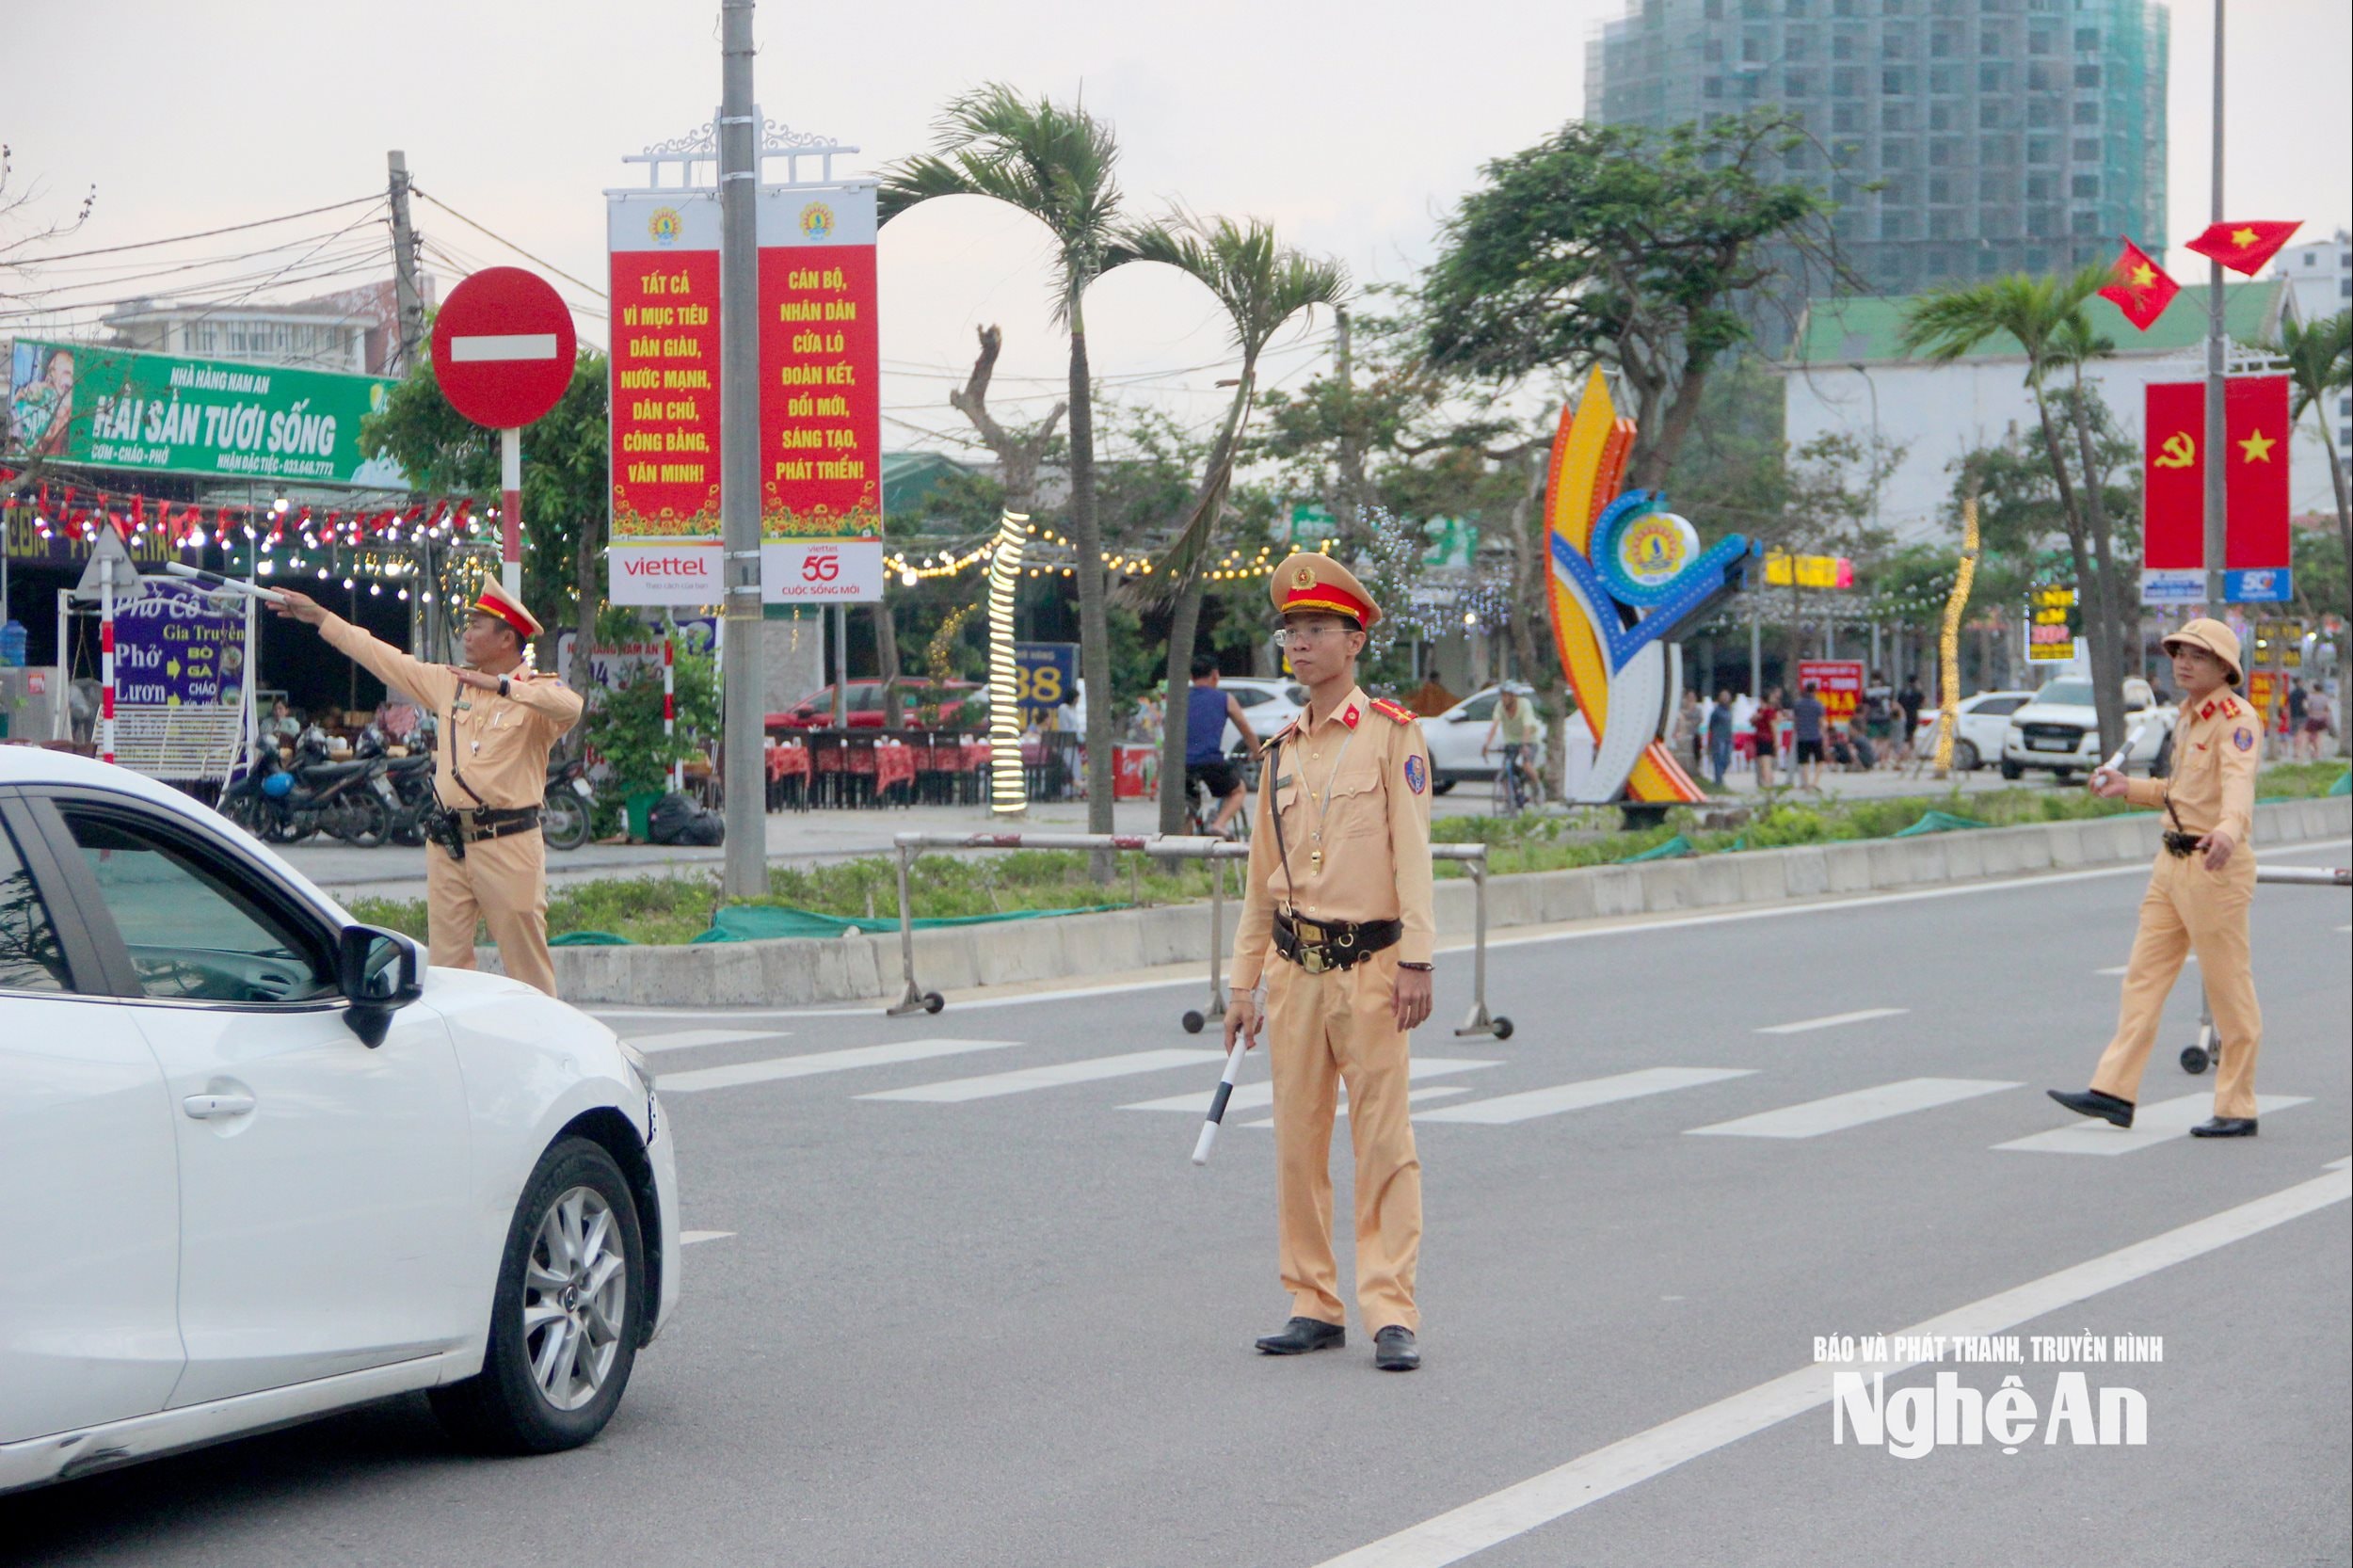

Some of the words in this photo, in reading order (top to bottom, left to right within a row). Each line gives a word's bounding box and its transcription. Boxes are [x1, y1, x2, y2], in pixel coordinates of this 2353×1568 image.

[642, 270, 666, 294] TẤT
[670, 270, 690, 294] CẢ
[789, 268, 819, 289] CÁN
[823, 267, 847, 293] BỘ,
[624, 306, 637, 326] VÌ
[642, 307, 673, 328] MỤC
[678, 304, 708, 324] TIÊU
[780, 300, 822, 321] NHÂN
[825, 299, 856, 320] DÂN
[631, 336, 660, 357] DÂN
[664, 336, 702, 359] GIÀU,
[792, 329, 822, 353] CỬA
[826, 330, 843, 352] LÒ
[170, 364, 195, 388] NHÀ
[195, 365, 227, 391] HÀNG
[227, 373, 253, 392] NAM
[252, 376, 270, 394] AN
[621, 366, 660, 389] NƯỚC
[664, 370, 711, 392] MẠNH,
[782, 363, 823, 385] ĐOÀN
[826, 360, 856, 386] KẾT,
[632, 396, 663, 420] DÂN
[666, 395, 699, 422] CHỦ,
[789, 392, 812, 417] ĐỔI
[817, 393, 849, 418] MỚI,
[145, 388, 201, 446] SẢN
[204, 402, 266, 450] TƯƠI
[266, 397, 336, 456] SỐNG
[623, 430, 662, 452] CÔNG
[666, 427, 710, 453] BẰNG,
[782, 426, 822, 448] SÁNG
[826, 429, 857, 452] TẠO,
[216, 451, 242, 472] NHẬN
[628, 461, 657, 483] VĂN
[661, 464, 704, 482] MINH!
[776, 457, 813, 480] PHÁT
[817, 454, 864, 479] TRIỂN!
[625, 557, 708, 575] viettel
[802, 555, 839, 582] 5G
[782, 585, 808, 596] CUỘC
[810, 584, 839, 595] SỐNG
[840, 584, 859, 594] MỚI
[163, 624, 188, 641] Gia
[115, 644, 163, 668] Phở
[188, 645, 214, 659] BÒ
[187, 664, 213, 678] GÀ
[115, 678, 166, 703] Lươn
[188, 680, 216, 696] CHÁO
